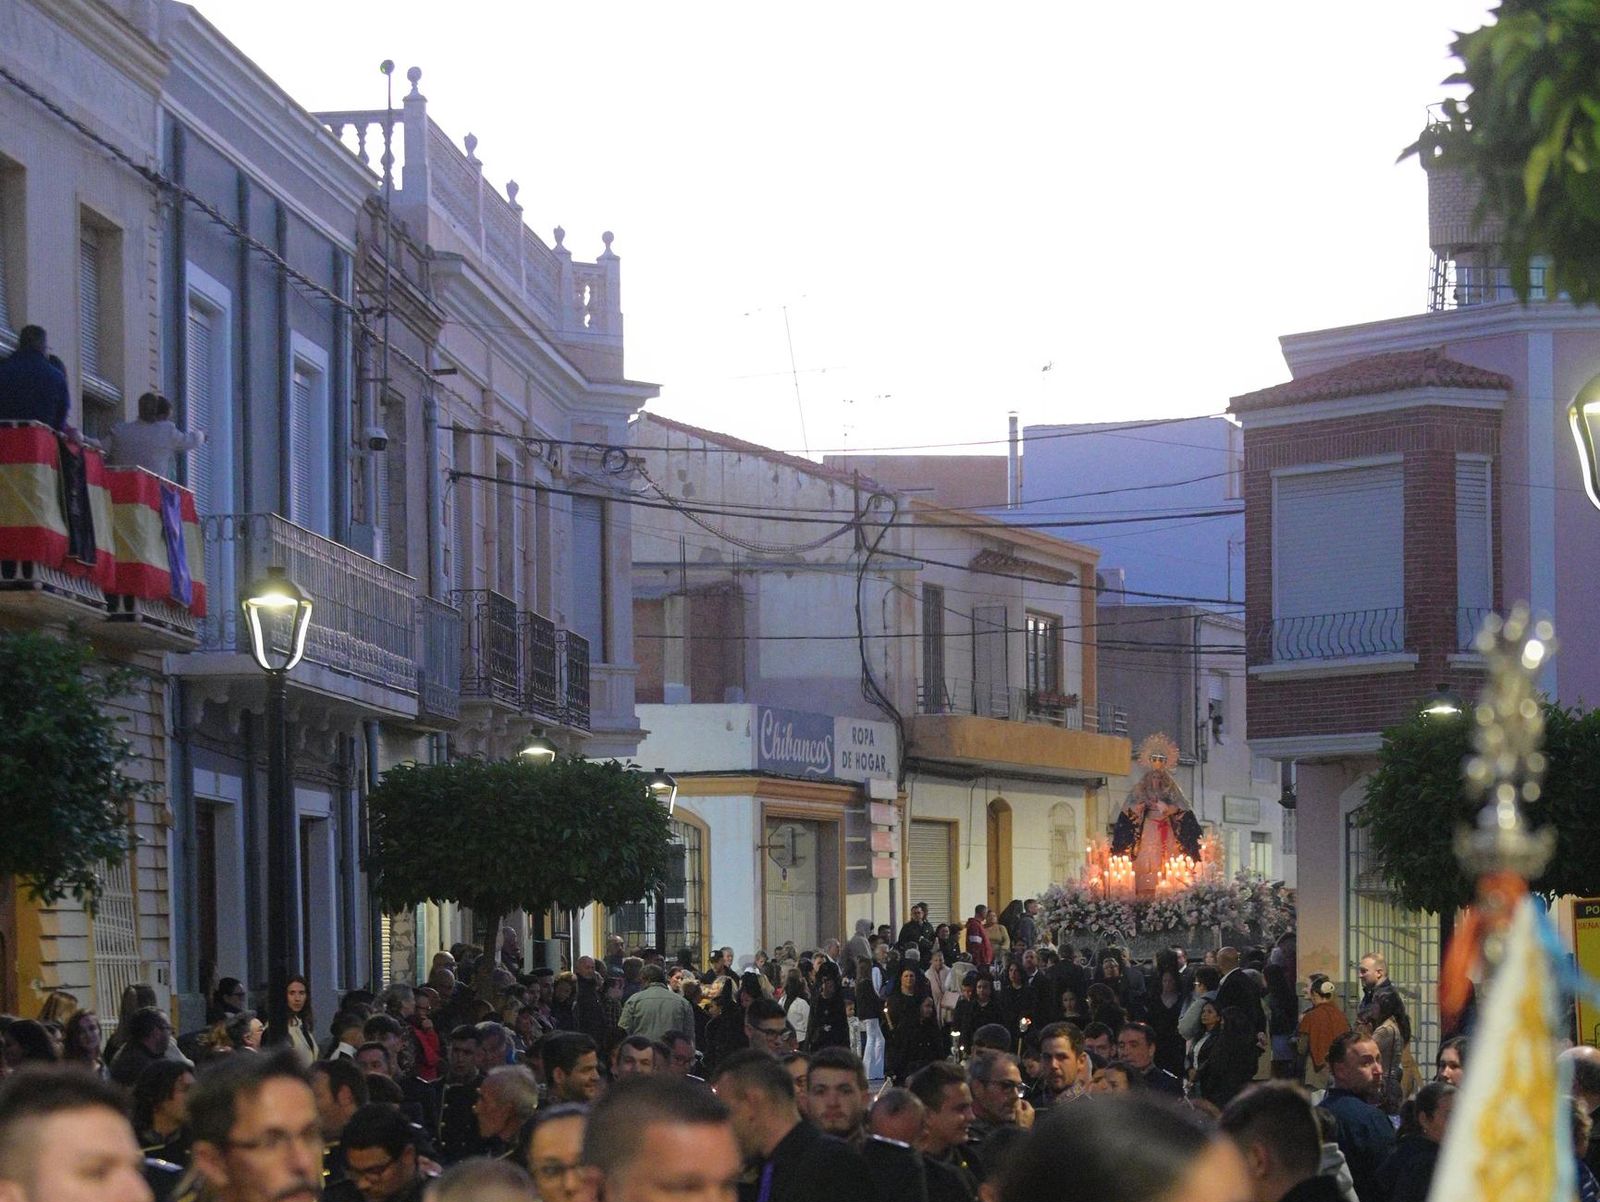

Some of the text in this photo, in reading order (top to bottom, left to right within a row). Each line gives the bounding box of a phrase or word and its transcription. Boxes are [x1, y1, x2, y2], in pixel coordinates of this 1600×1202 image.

[852, 727, 874, 746] ROPA
[842, 751, 886, 772] DE HOGAR
